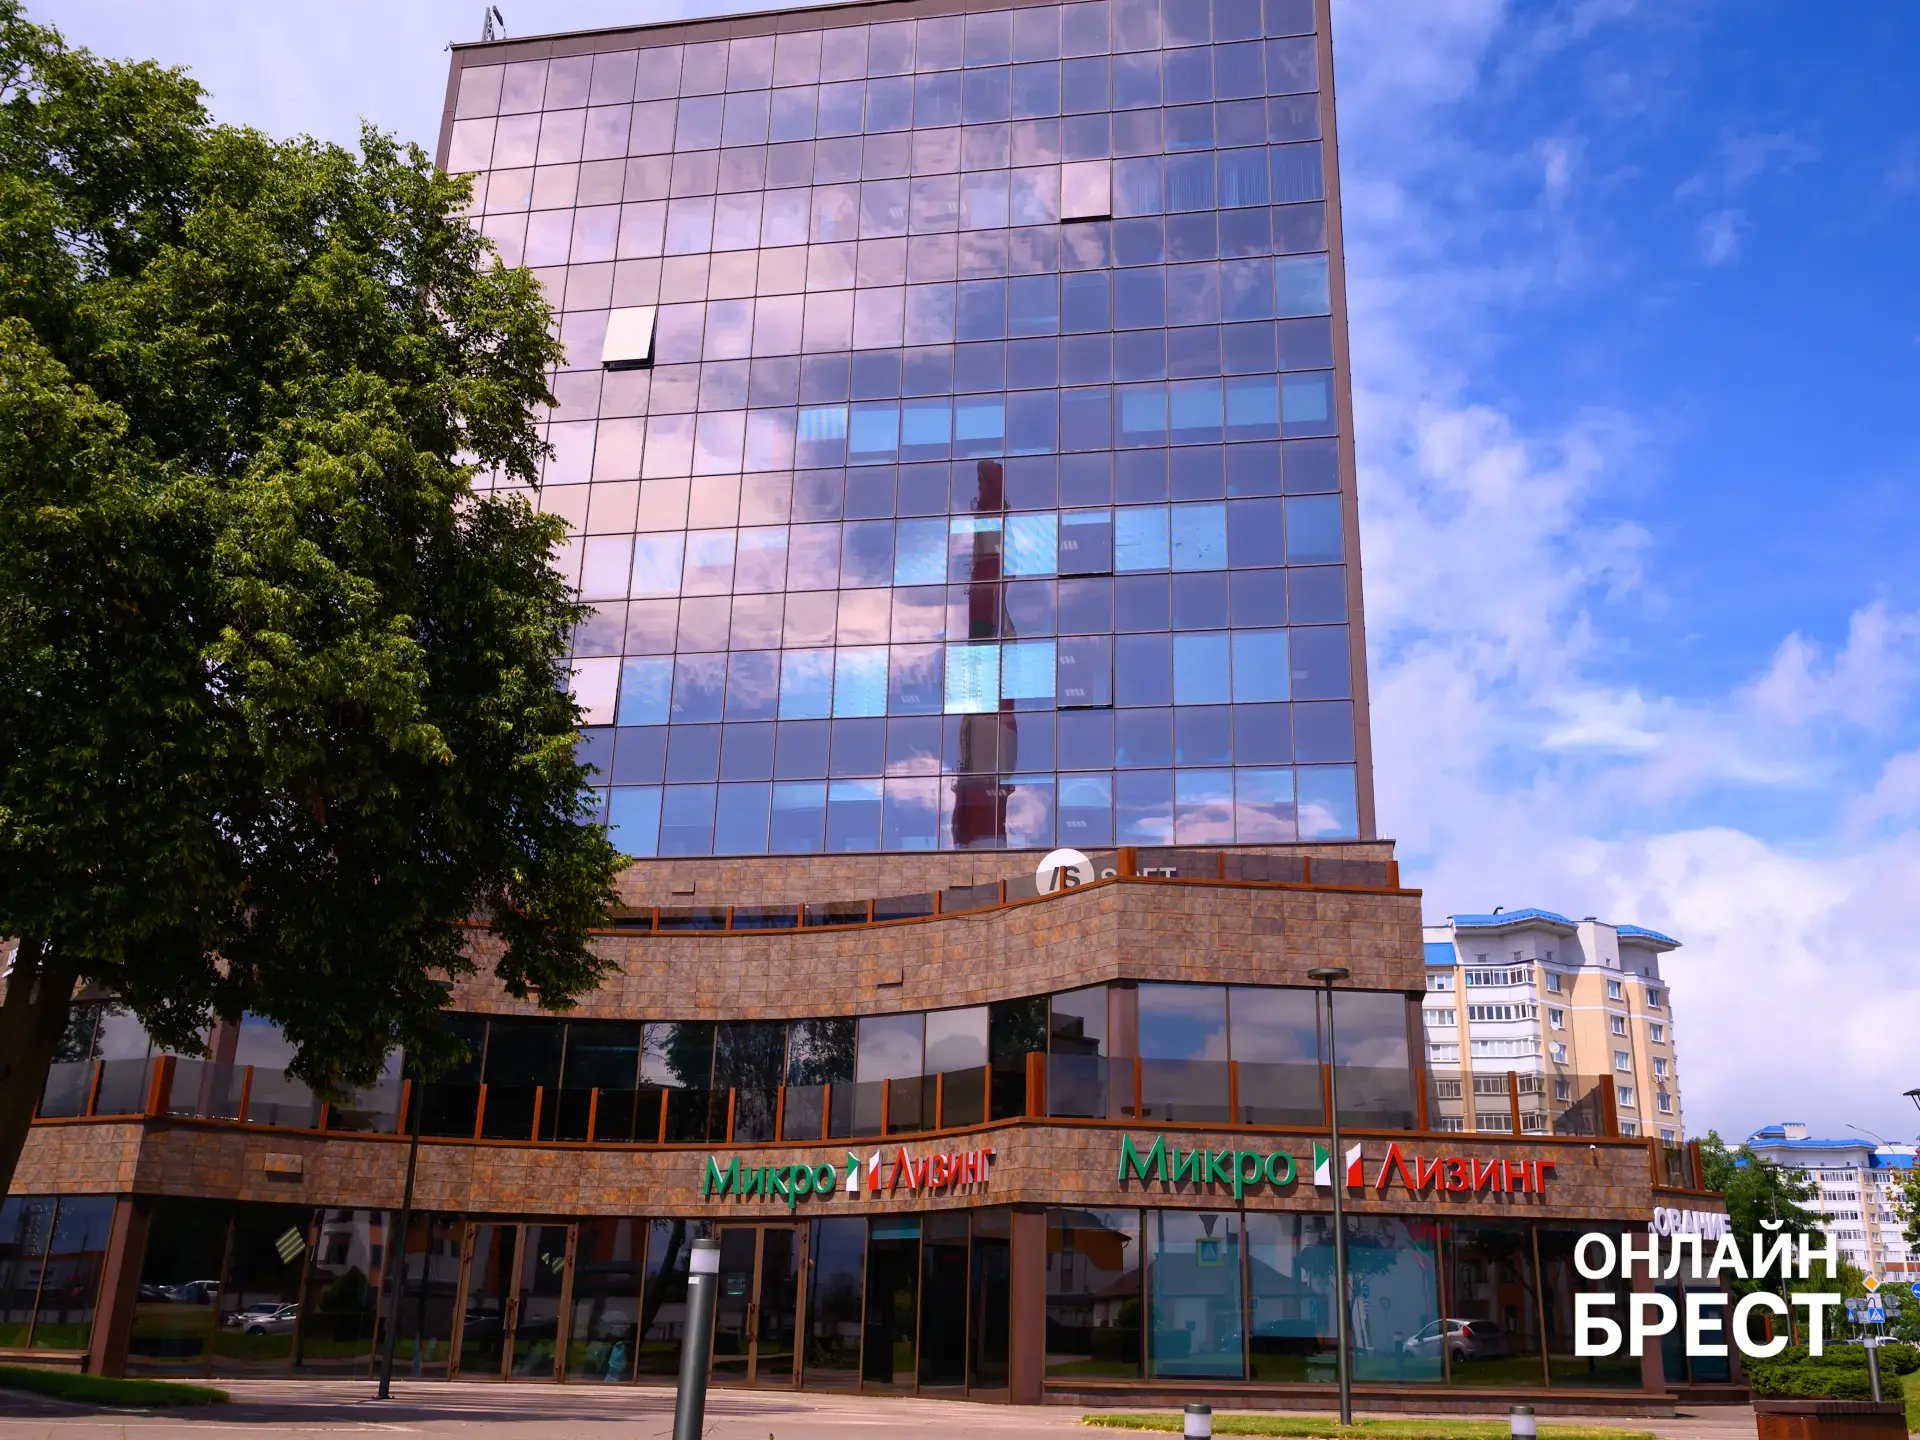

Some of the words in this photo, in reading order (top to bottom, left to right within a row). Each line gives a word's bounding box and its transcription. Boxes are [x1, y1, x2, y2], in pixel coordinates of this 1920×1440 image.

[702, 1155, 836, 1209] Микро
[888, 1146, 997, 1191] Лизинг
[1118, 1133, 1297, 1200] Микро
[1375, 1142, 1556, 1194] Лизинг
